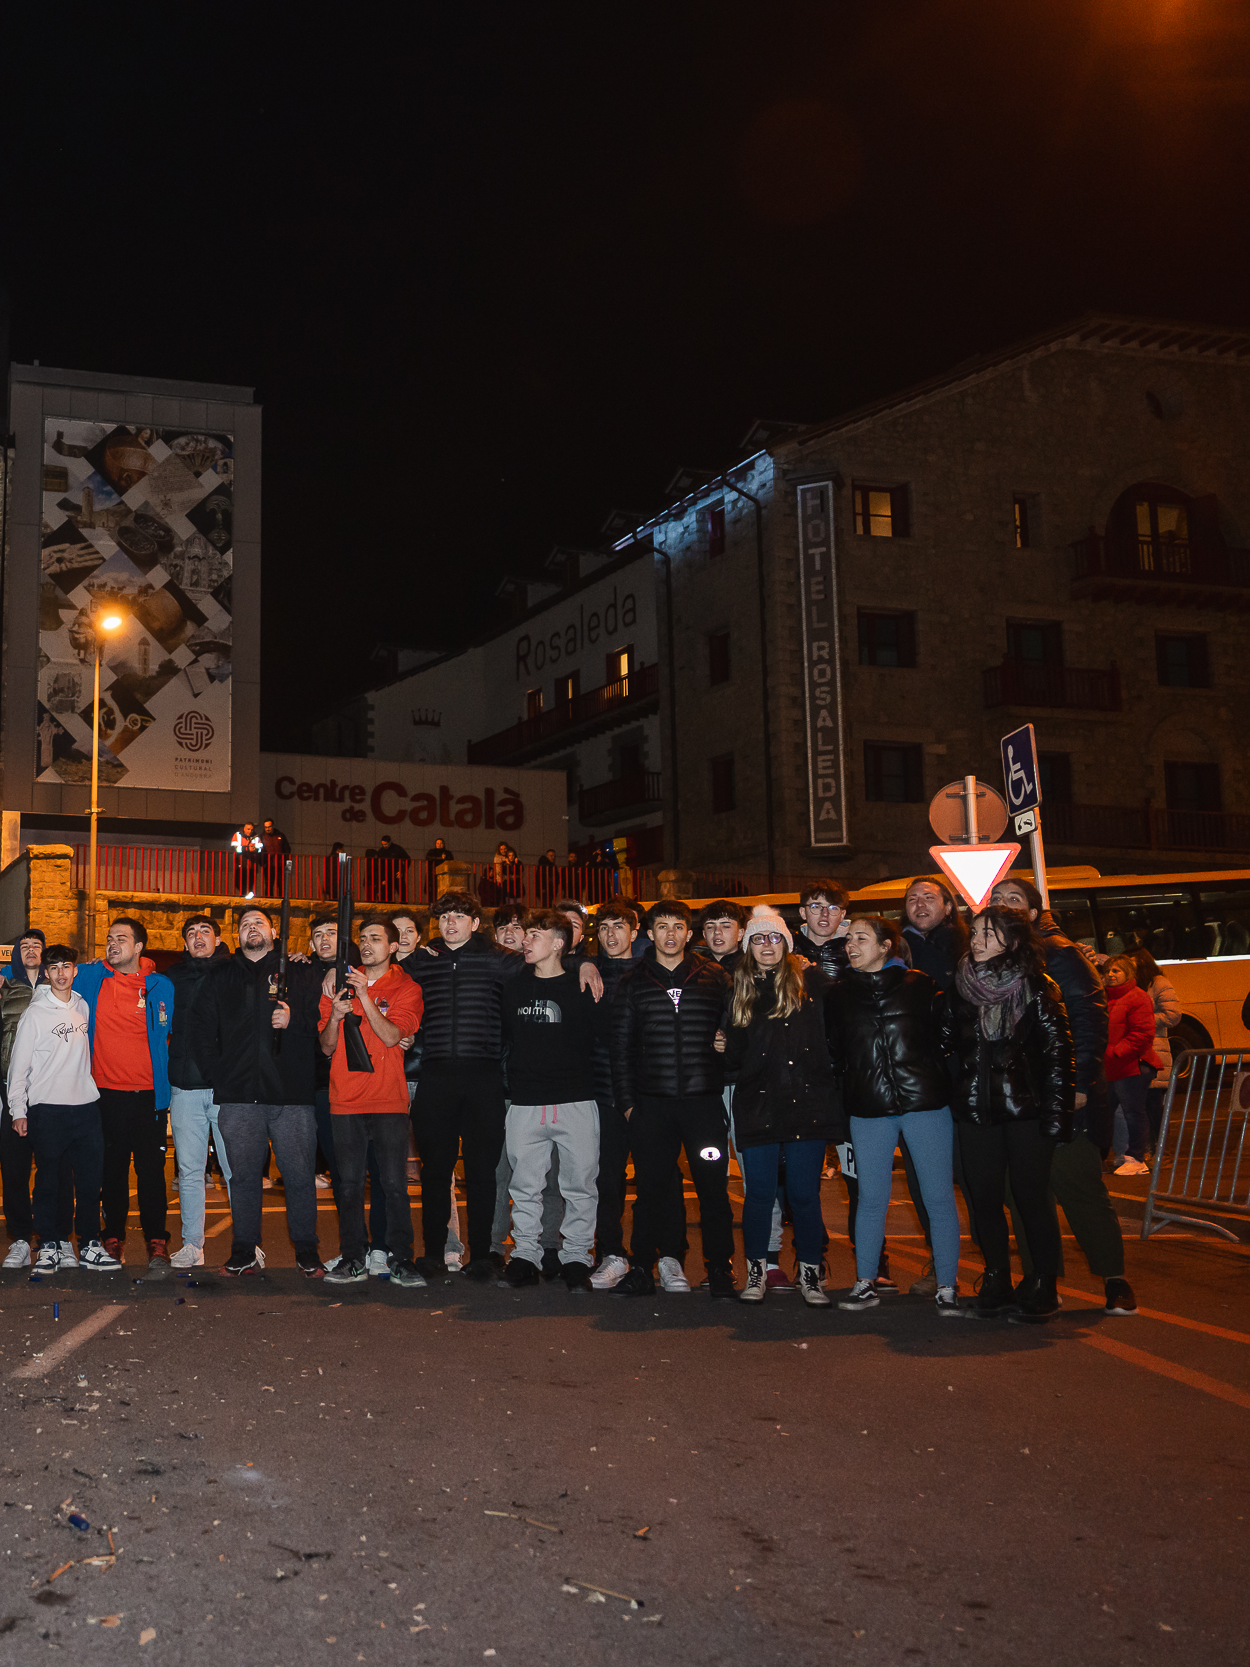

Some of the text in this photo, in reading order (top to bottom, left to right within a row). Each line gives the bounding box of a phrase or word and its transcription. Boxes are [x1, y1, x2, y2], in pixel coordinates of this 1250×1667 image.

[516, 585, 637, 681] Rosaleda
[806, 489, 838, 821] HOTEL ROSALEDA
[275, 776, 366, 803] Centre
[341, 781, 524, 831] de Català
